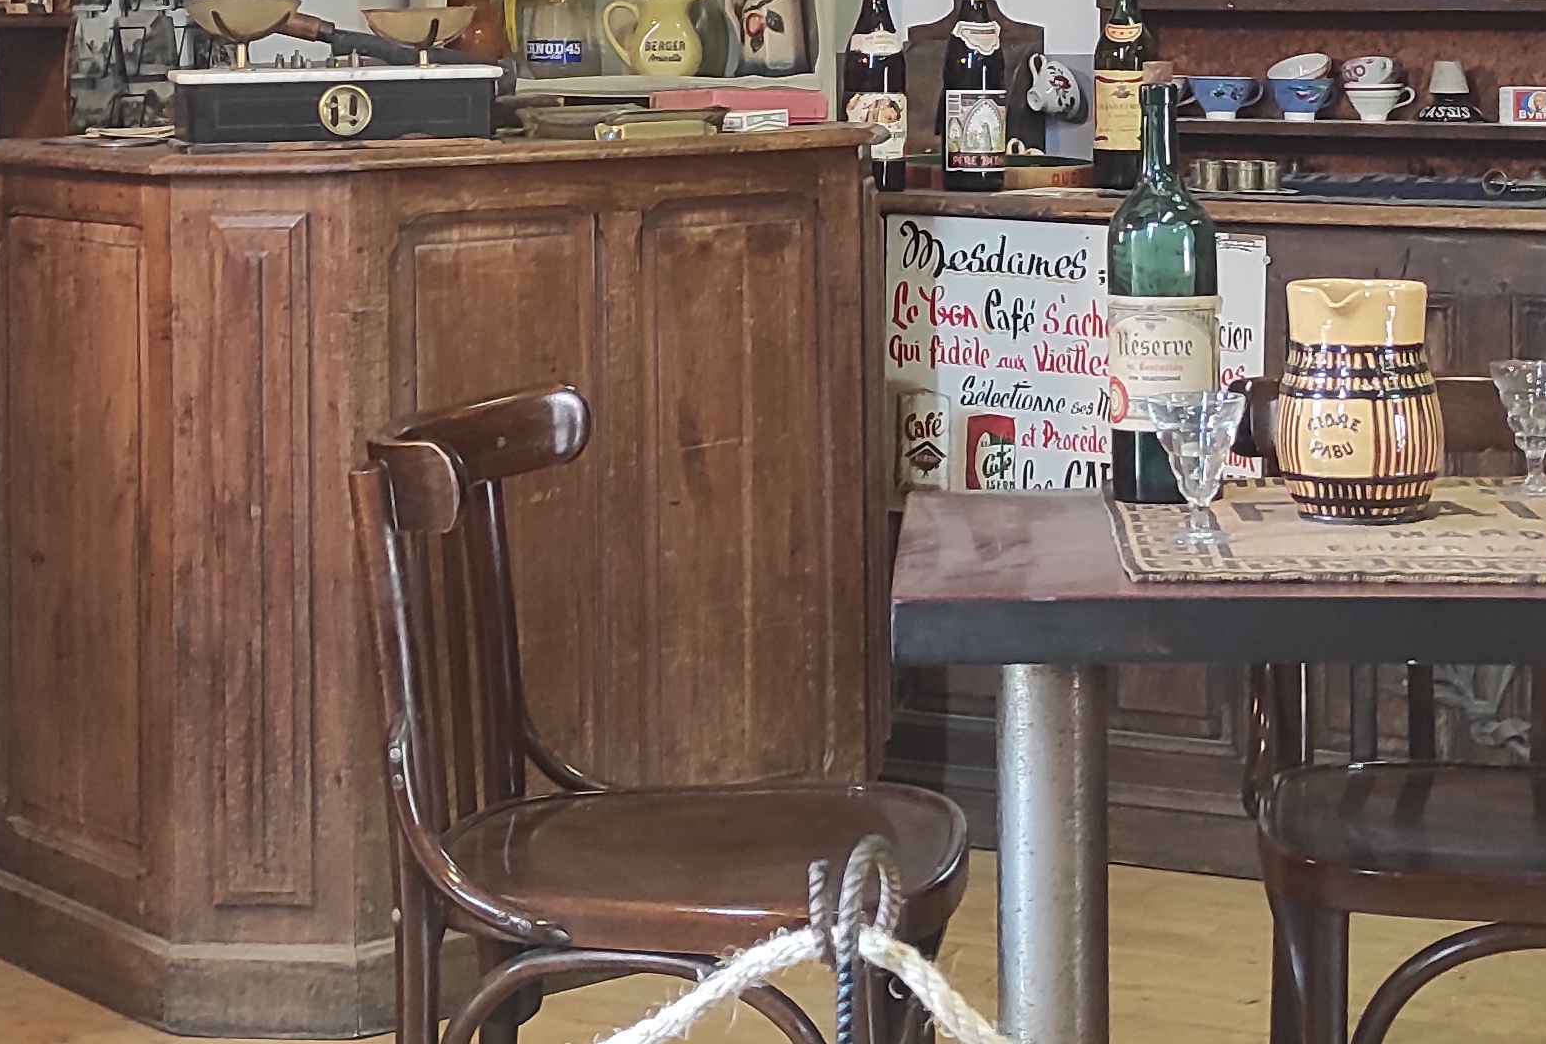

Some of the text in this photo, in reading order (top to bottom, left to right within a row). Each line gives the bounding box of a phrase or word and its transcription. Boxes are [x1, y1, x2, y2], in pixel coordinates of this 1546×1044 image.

[1419, 105, 1471, 120] CASSIS
[900, 220, 1087, 280] Mesdames
[890, 281, 920, 331] Le
[984, 288, 1036, 340] Café
[889, 335, 922, 372] Qui
[928, 335, 991, 370] fidèle
[996, 355, 1027, 373] aux
[1117, 332, 1193, 358] Réserve
[960, 375, 1066, 415] Sélectionne
[905, 412, 944, 441] Café
[1021, 419, 1108, 455] et Procède
[1307, 413, 1362, 433] CIDRE
